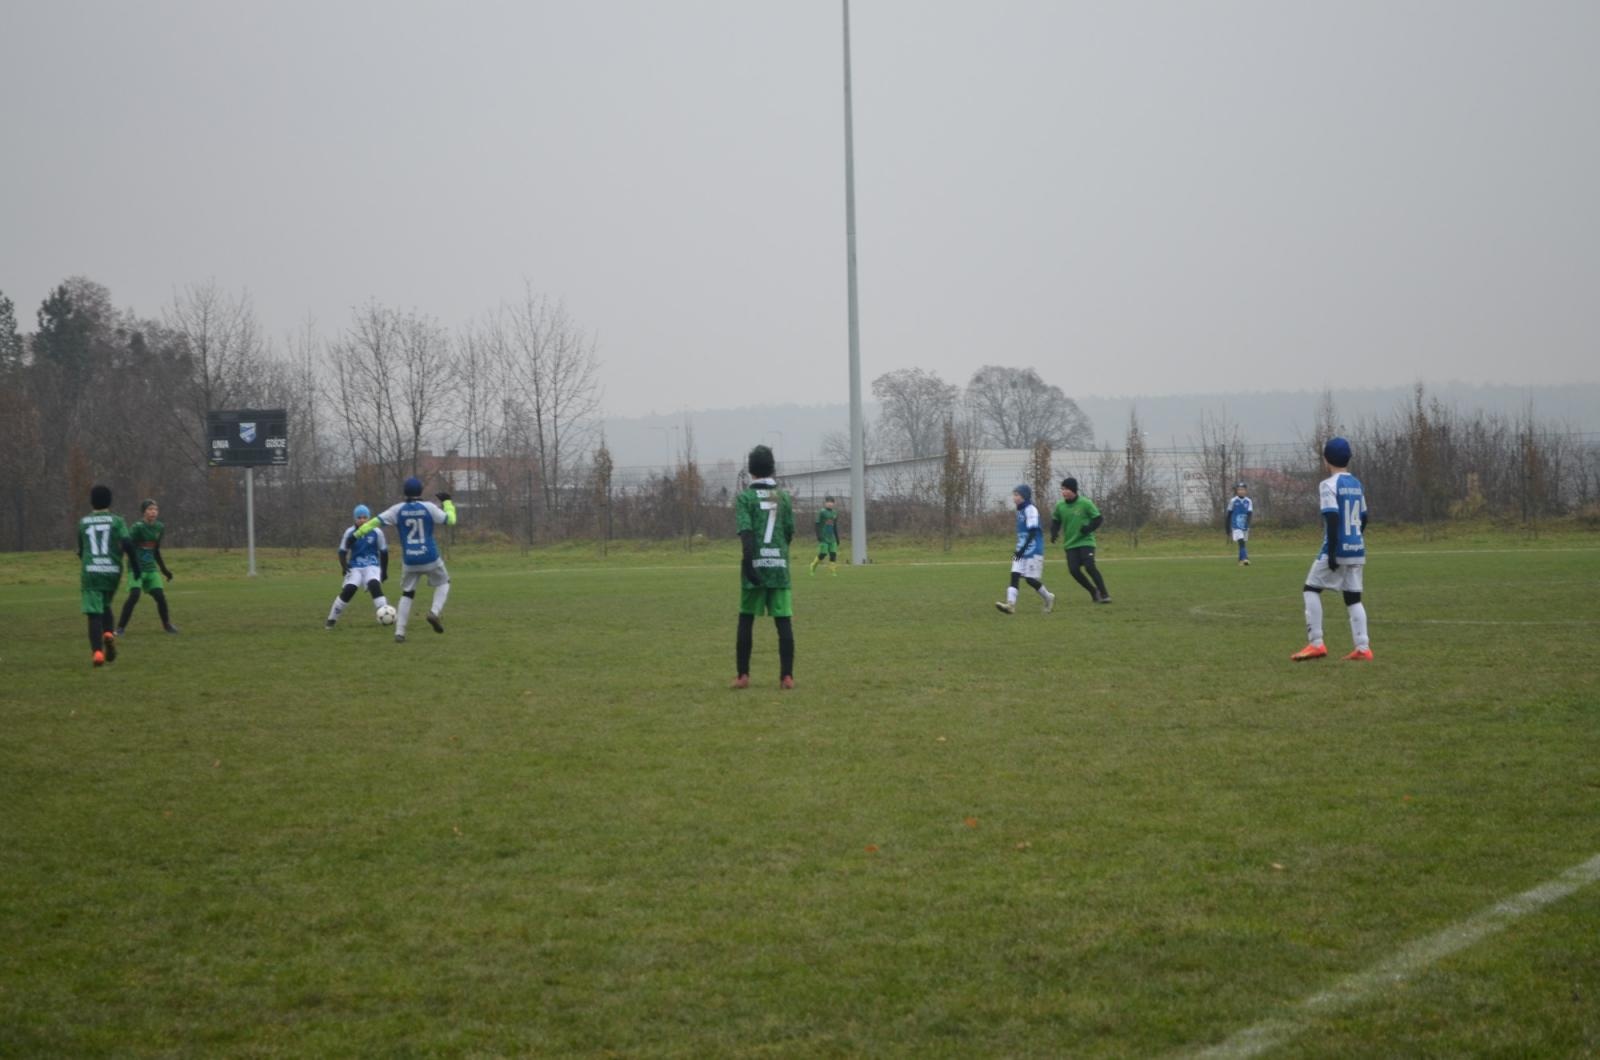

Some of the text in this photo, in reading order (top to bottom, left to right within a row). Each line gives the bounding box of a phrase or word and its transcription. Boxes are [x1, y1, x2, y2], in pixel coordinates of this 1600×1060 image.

[405, 518, 426, 545] 21
[759, 501, 778, 544] 7
[1344, 499, 1362, 536] 14
[85, 524, 111, 556] 17
